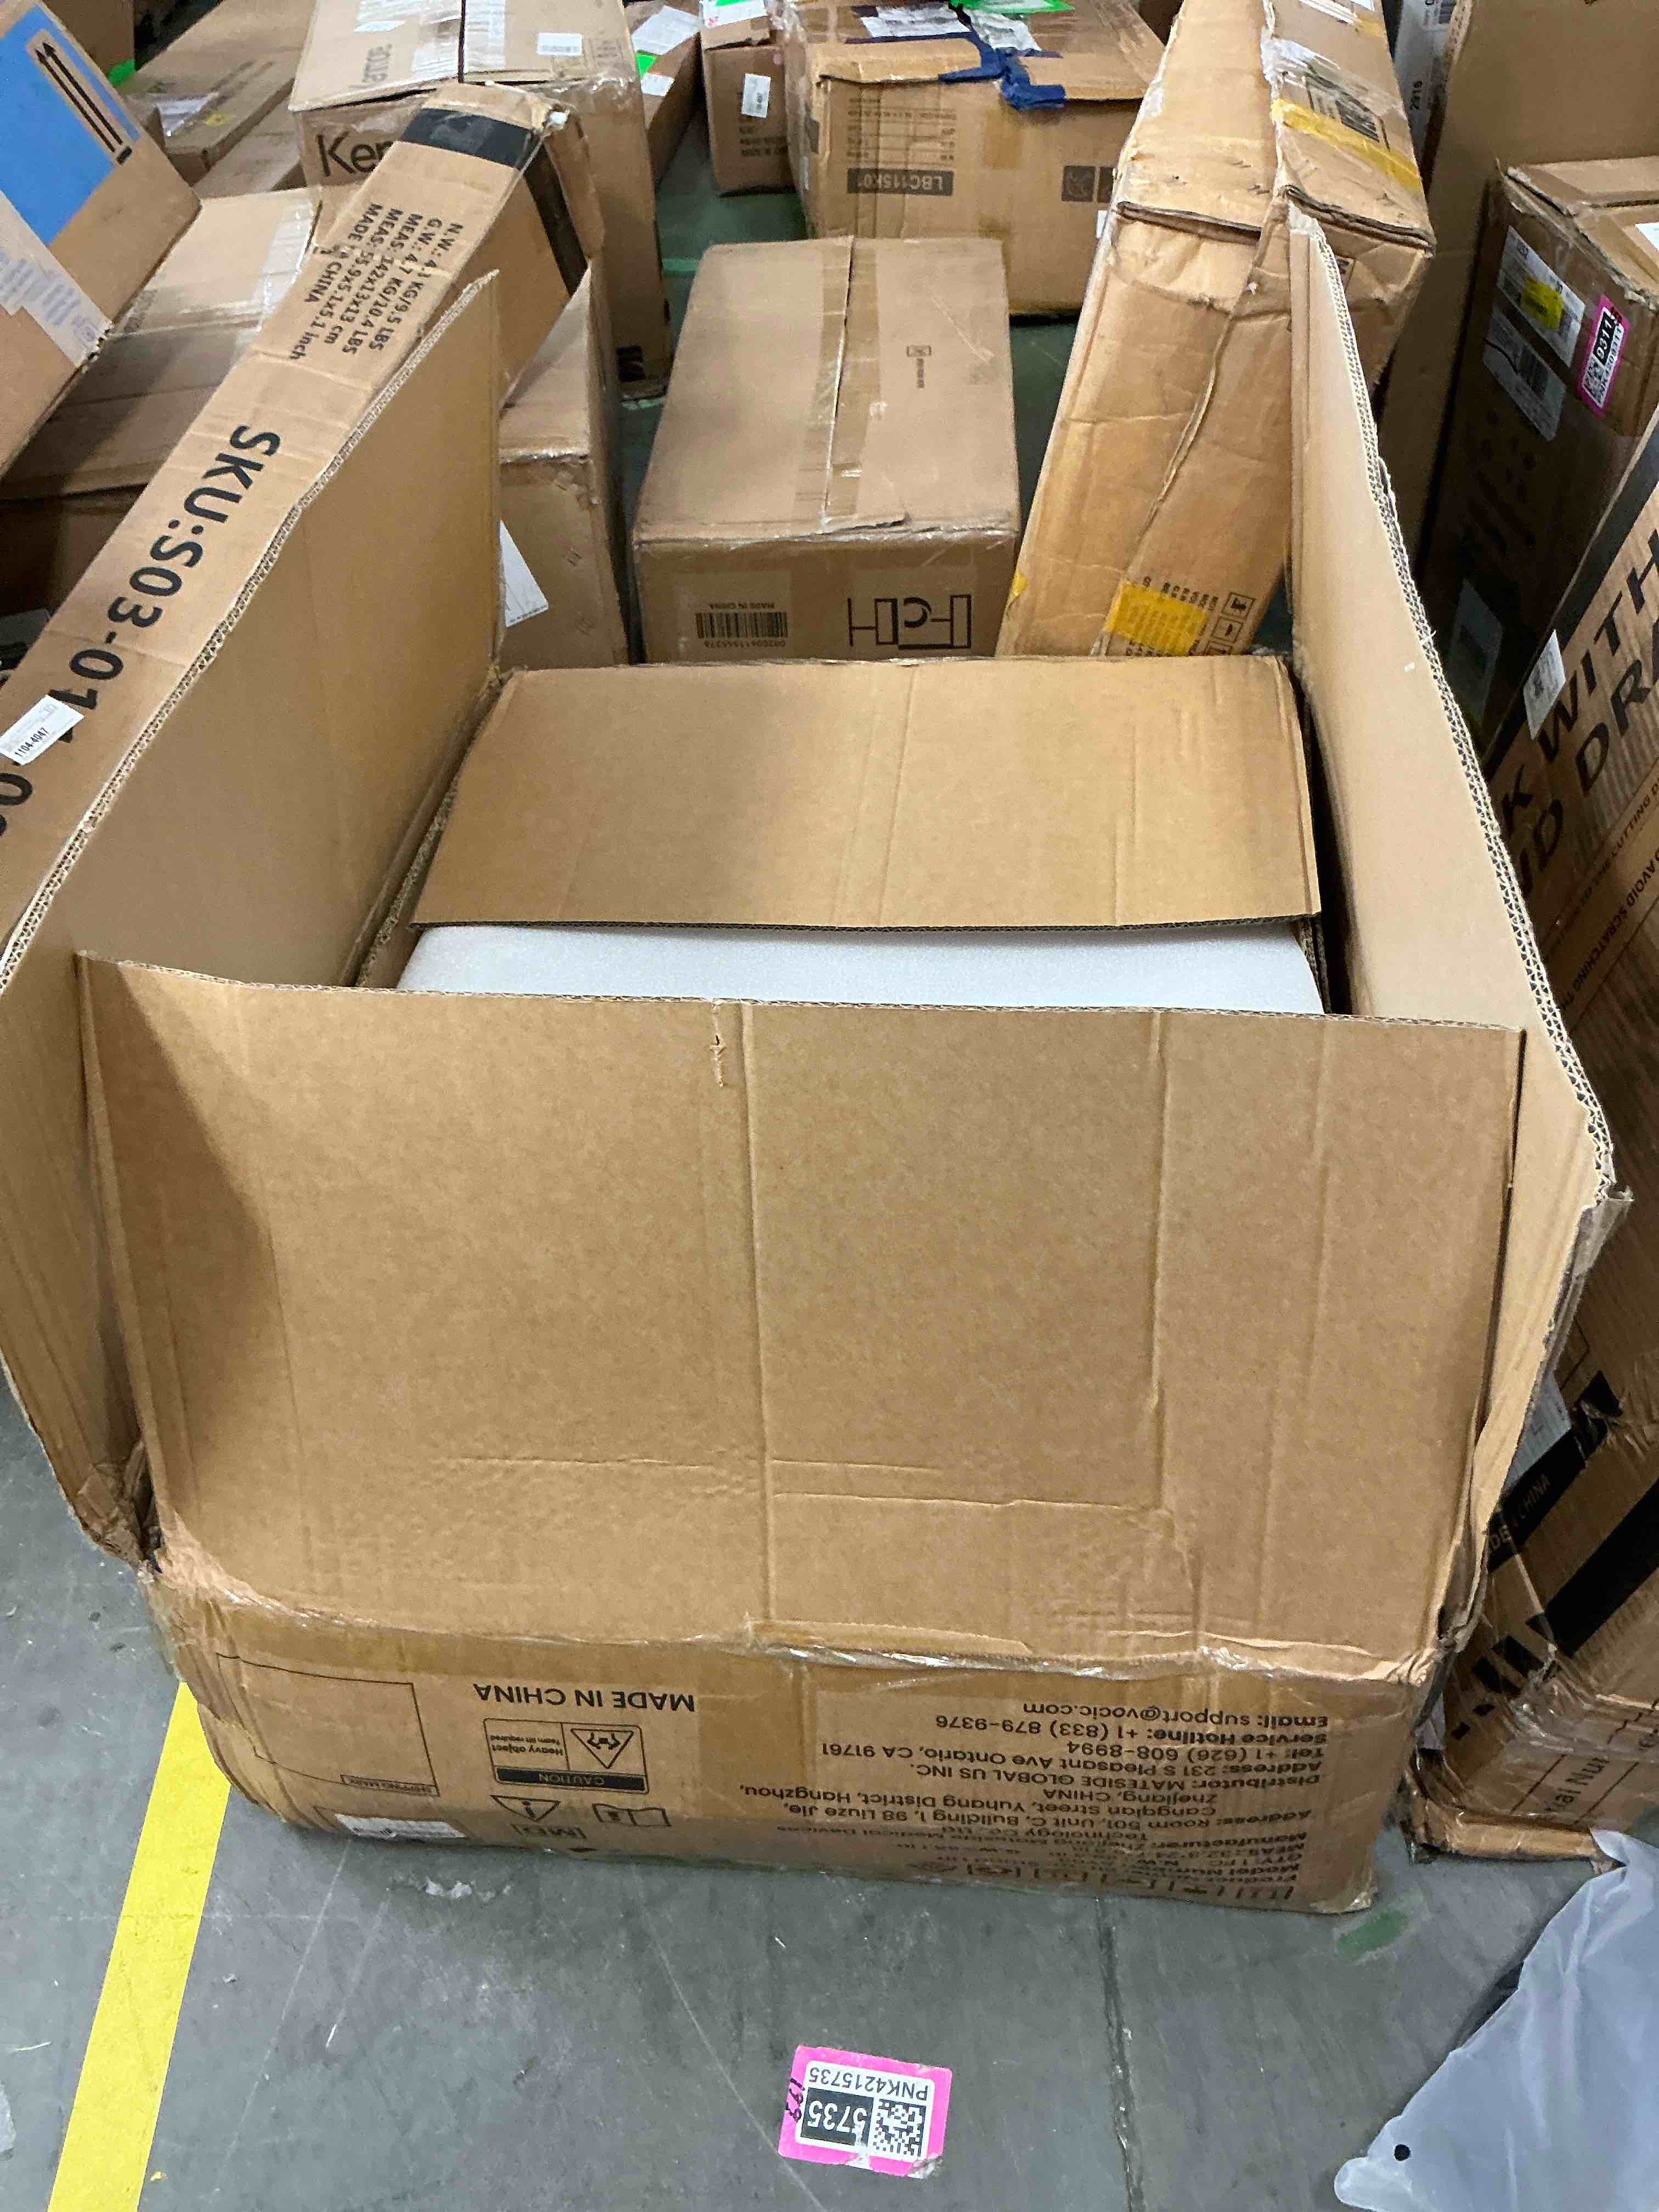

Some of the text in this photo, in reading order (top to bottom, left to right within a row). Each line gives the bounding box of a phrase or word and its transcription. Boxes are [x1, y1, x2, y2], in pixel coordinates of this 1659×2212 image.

[347, 201, 383, 242] MADE
[304, 261, 343, 303] CHINA
[324, 325, 344, 345] cm
[342, 329, 369, 355] LBS
[368, 327, 394, 351] LBS
[1538, 528, 1659, 763] WITH
[1626, 856, 1656, 909] AVOID
[472, 1683, 696, 1712] MADE IN CHINA
[1023, 1702, 1329, 1728] Email: support@vocic.com
[935, 1715, 1328, 1746] Service Hotline: +1 (833) 879-9376
[492, 1744, 564, 1757] Heavy object
[822, 1742, 1322, 1778] Address: 231 S Pleasant Ave Ontario, CA 91761
[1066, 1741, 1325, 1764] Tel: +1 (626) 608-8994
[538, 1773, 606, 1786] CAUTION
[910, 1763, 1321, 1791] Distributor: MATESIDE GLOBAL US INC.
[740, 1784, 851, 1804] Hangzhou,
[856, 1791, 936, 1808] District,
[943, 1794, 1025, 1813] Yuhang
[1042, 1788, 1218, 1805] Zhejiang, CHINA
[783, 1802, 820, 1817] Jie,
[824, 1807, 876, 1820] Liuze
[882, 1810, 908, 1821] 98
[933, 1809, 1019, 1826] Building
[1032, 1801, 1101, 1816] Street,
[1218, 1809, 1313, 1826] Address:
[1049, 1815, 1096, 1829] Unit
[1100, 1817, 1143, 1831] 501,
[1150, 1818, 1210, 1830] Room
[808, 2067, 929, 2101] PNK4215735
[807, 2100, 868, 2135] 5735
